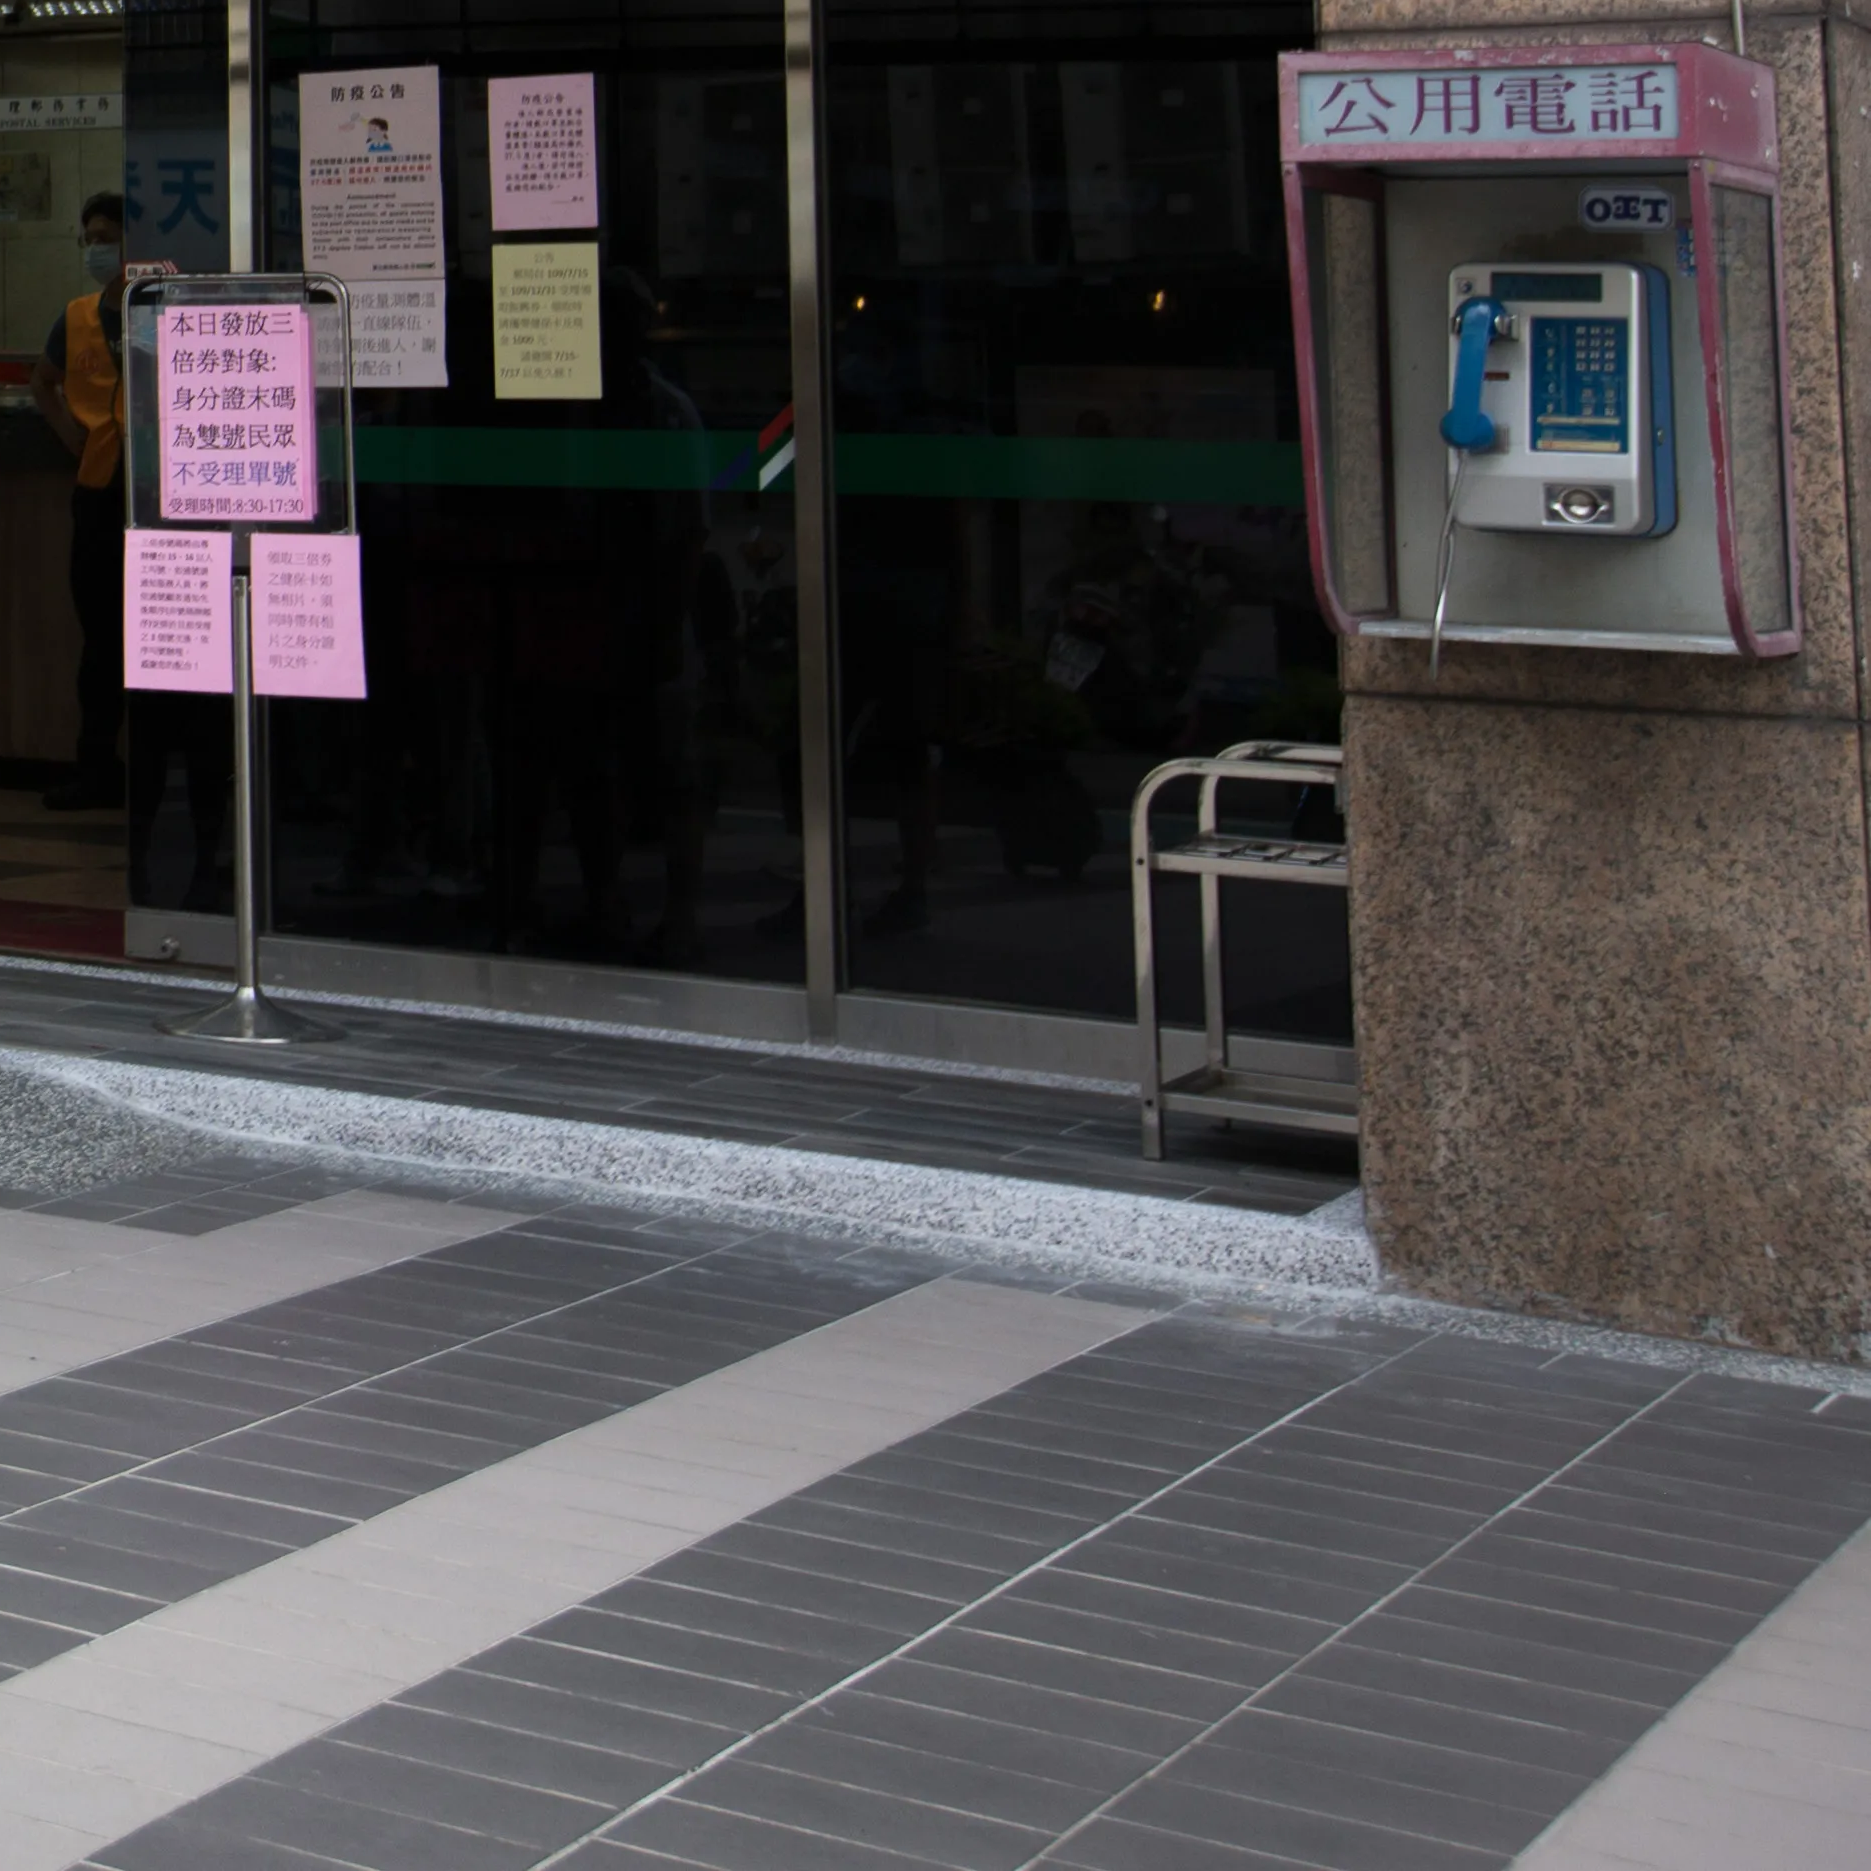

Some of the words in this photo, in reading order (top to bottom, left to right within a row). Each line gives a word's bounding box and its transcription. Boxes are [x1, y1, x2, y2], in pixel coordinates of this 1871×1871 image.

[331, 84, 405, 102] 防疫公告
[1318, 70, 1665, 138] 公用電話
[0, 119, 39, 128] POSTAL
[45, 117, 96, 127] SERVICES
[547, 268, 588, 279] 109/7/15
[171, 311, 294, 337] 本日發放三
[172, 385, 295, 411] 身分證末碼
[172, 424, 296, 449] 為雙號民眾
[172, 461, 297, 486] 不受理單號
[168, 497, 304, 514] 受理時間:8:30-17:30
